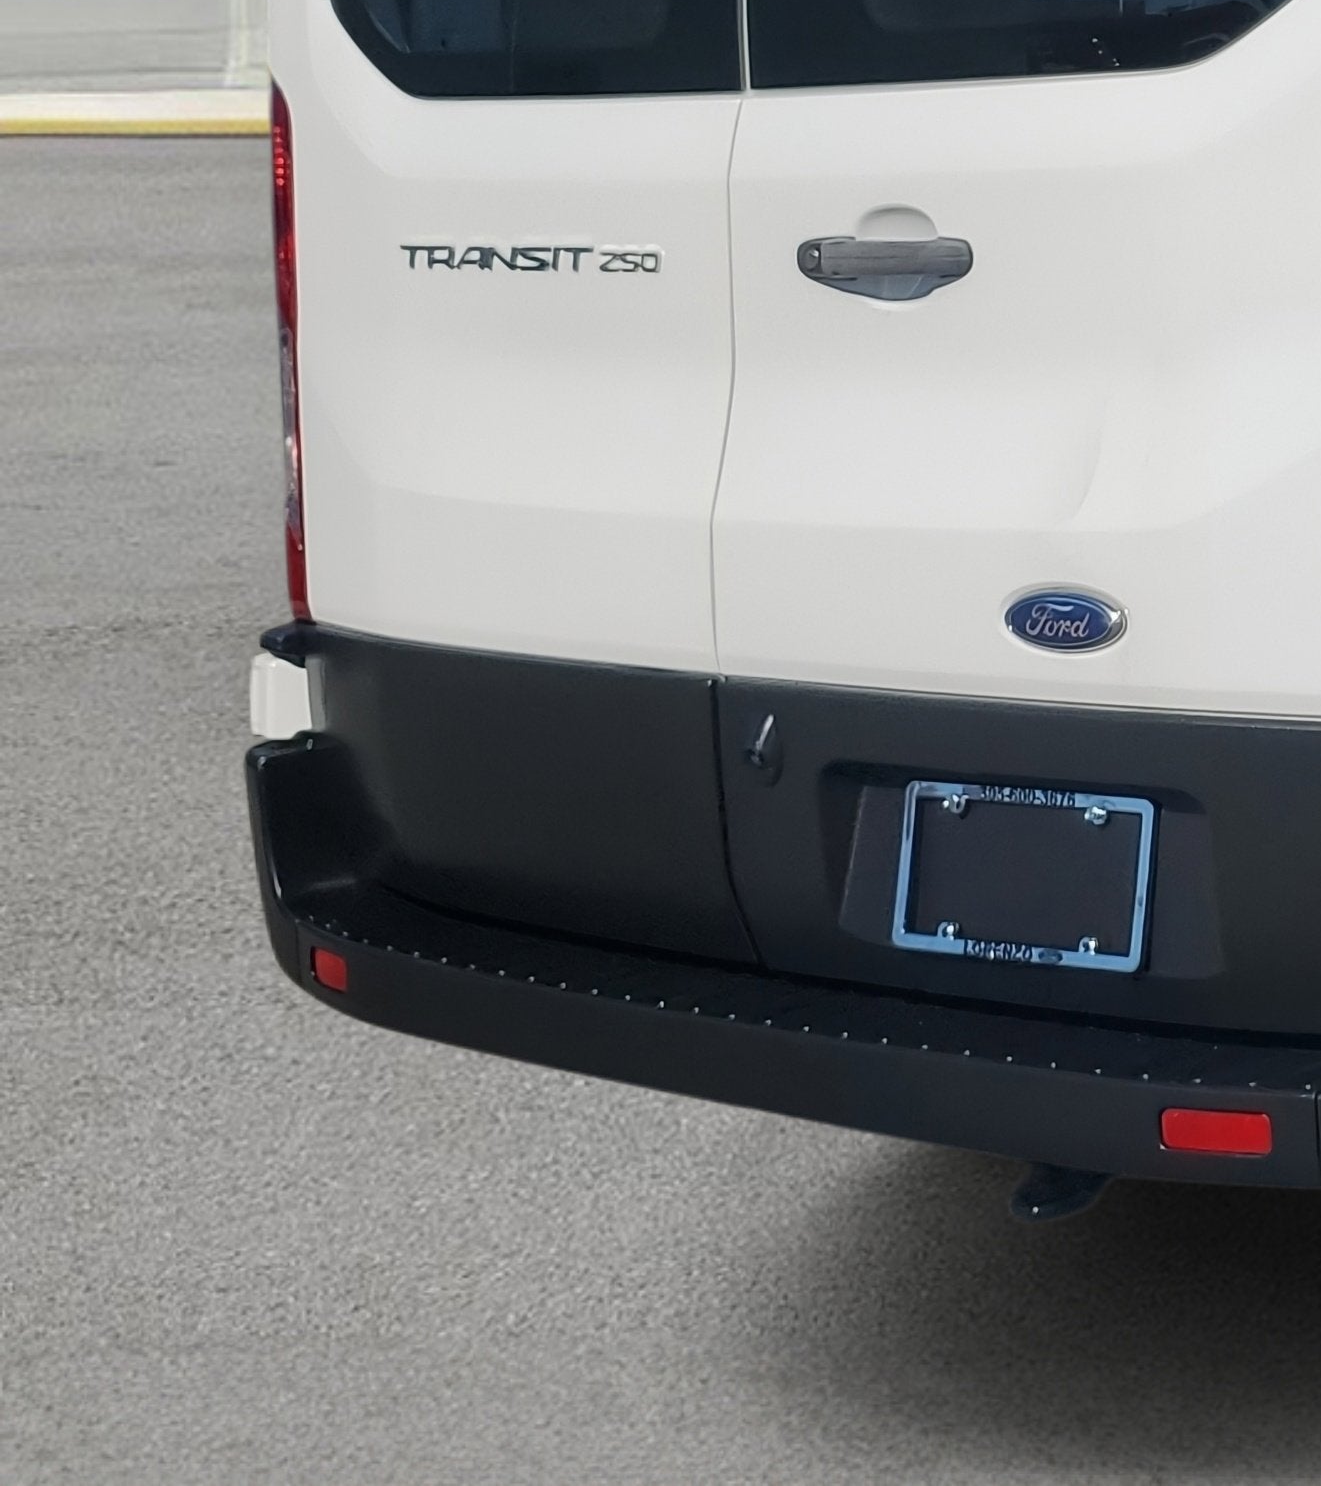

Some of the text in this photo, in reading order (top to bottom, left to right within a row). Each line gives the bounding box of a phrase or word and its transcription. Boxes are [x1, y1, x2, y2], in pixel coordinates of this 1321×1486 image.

[400, 245, 662, 273] TRANSIT 250
[1025, 602, 1090, 638] Ford
